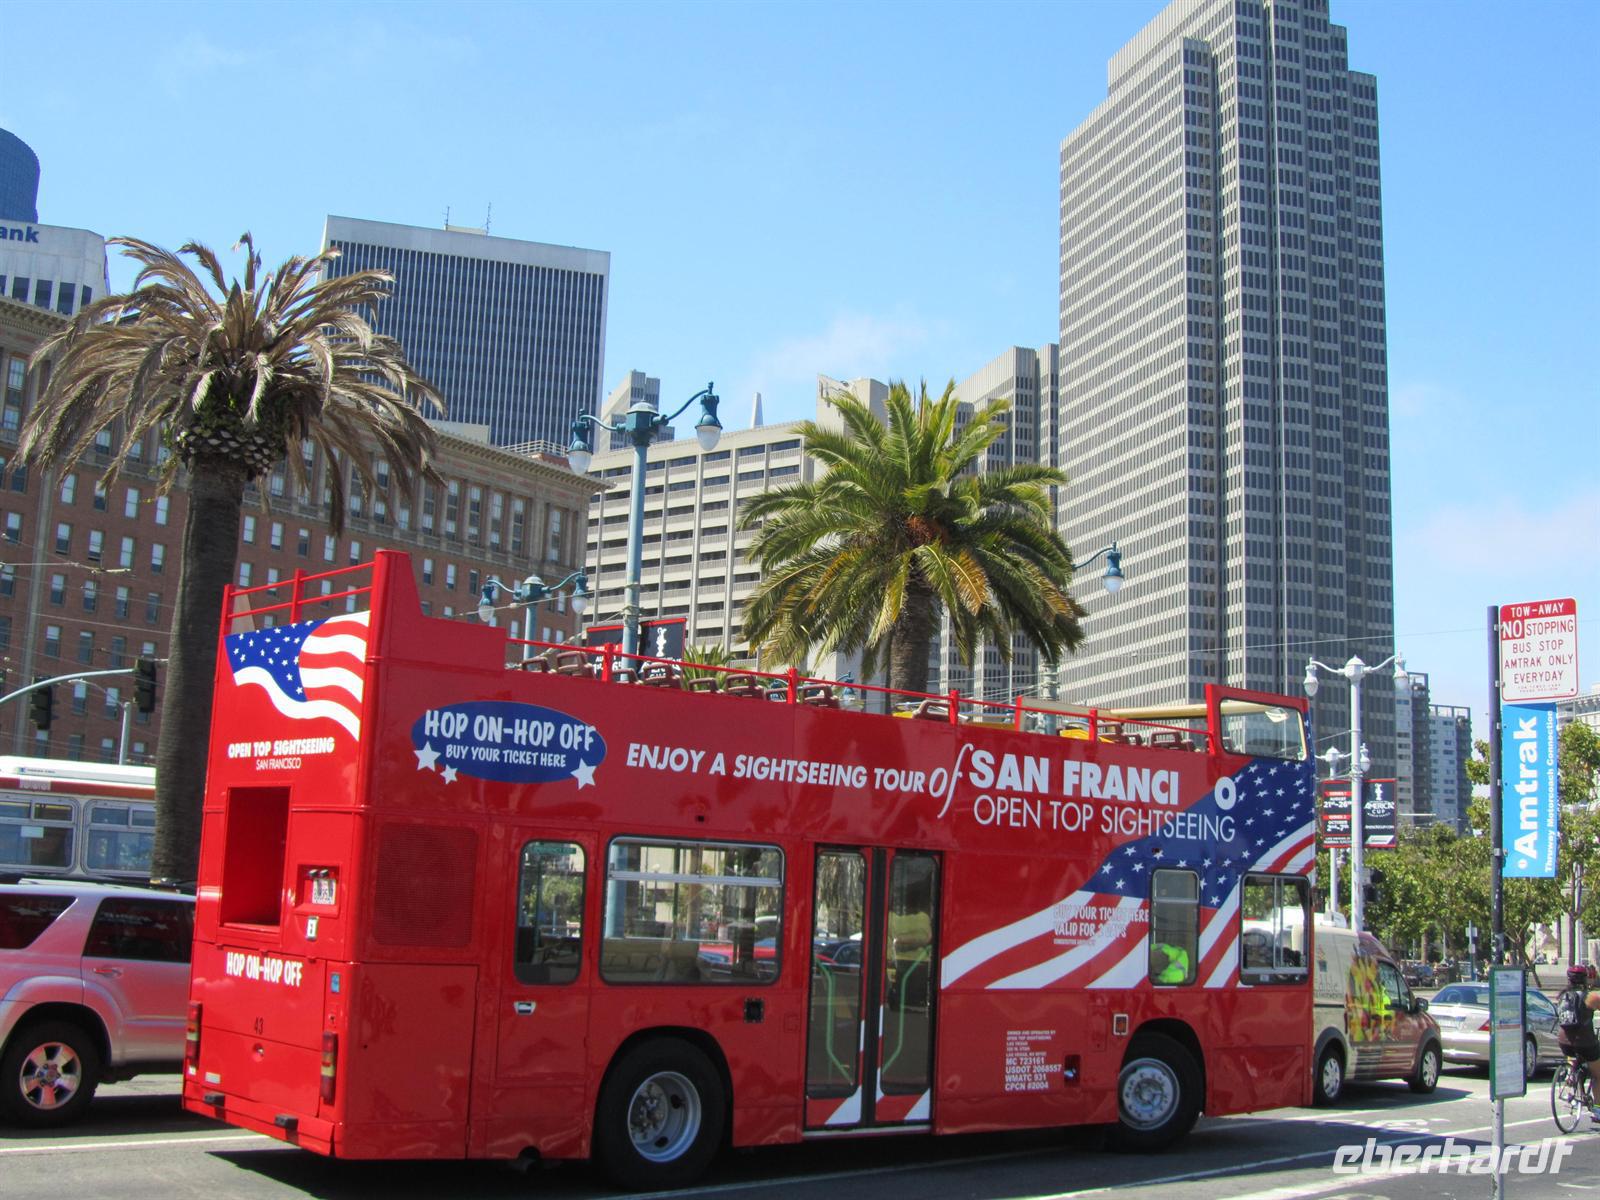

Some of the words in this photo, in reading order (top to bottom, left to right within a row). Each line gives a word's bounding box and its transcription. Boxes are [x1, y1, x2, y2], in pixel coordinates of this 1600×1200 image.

[1511, 602, 1564, 618] TOW-AWAY
[1502, 620, 1522, 639] NO
[1526, 619, 1574, 636] STOPPING
[1512, 642, 1531, 654] BUS
[1539, 639, 1564, 651] STOP
[1504, 656, 1542, 669] AMTRAK
[1548, 653, 1573, 666] ONLY
[1514, 670, 1564, 684] EVERYDAY
[424, 709, 469, 740] HOP
[473, 714, 555, 748] ON-HOP
[559, 724, 596, 751] OFF
[228, 742, 251, 758] OPEN
[253, 741, 271, 757] TOP
[273, 737, 335, 756] SIGHTSEEING
[445, 744, 469, 760] BUY
[471, 747, 500, 762] YOUR
[502, 749, 538, 766] TICKET
[540, 753, 566, 768] HERE
[256, 759, 268, 771] SAN
[269, 757, 302, 770] FRANCISCO
[626, 742, 705, 773] ENJOY
[709, 752, 726, 776] A
[733, 754, 868, 789] SIGHTSEEING
[873, 767, 925, 793] TOUR
[929, 743, 974, 819] of
[969, 749, 1050, 796] SAN
[1513, 716, 1539, 860] Amtrak
[1546, 768, 1555, 827] Motorcoach
[973, 794, 1041, 829] OPEN
[1050, 800, 1094, 832] TOP
[1101, 805, 1236, 842] SIGHTSEEING
[1544, 829, 1556, 873] Thruway
[1074, 904, 1097, 920] YOUR
[1127, 908, 1149, 923] HERE
[1054, 921, 1078, 936] VALID
[1079, 922, 1095, 937] FOR
[226, 951, 245, 977] HOP
[284, 960, 303, 987] OFF
[255, 1016, 264, 1035] 43
[1005, 1065, 1031, 1074] USDOT
[1006, 1057, 1018, 1066] MC
[1004, 1082, 1025, 1092] CPCN
[1005, 1073, 1032, 1082] WMATC
